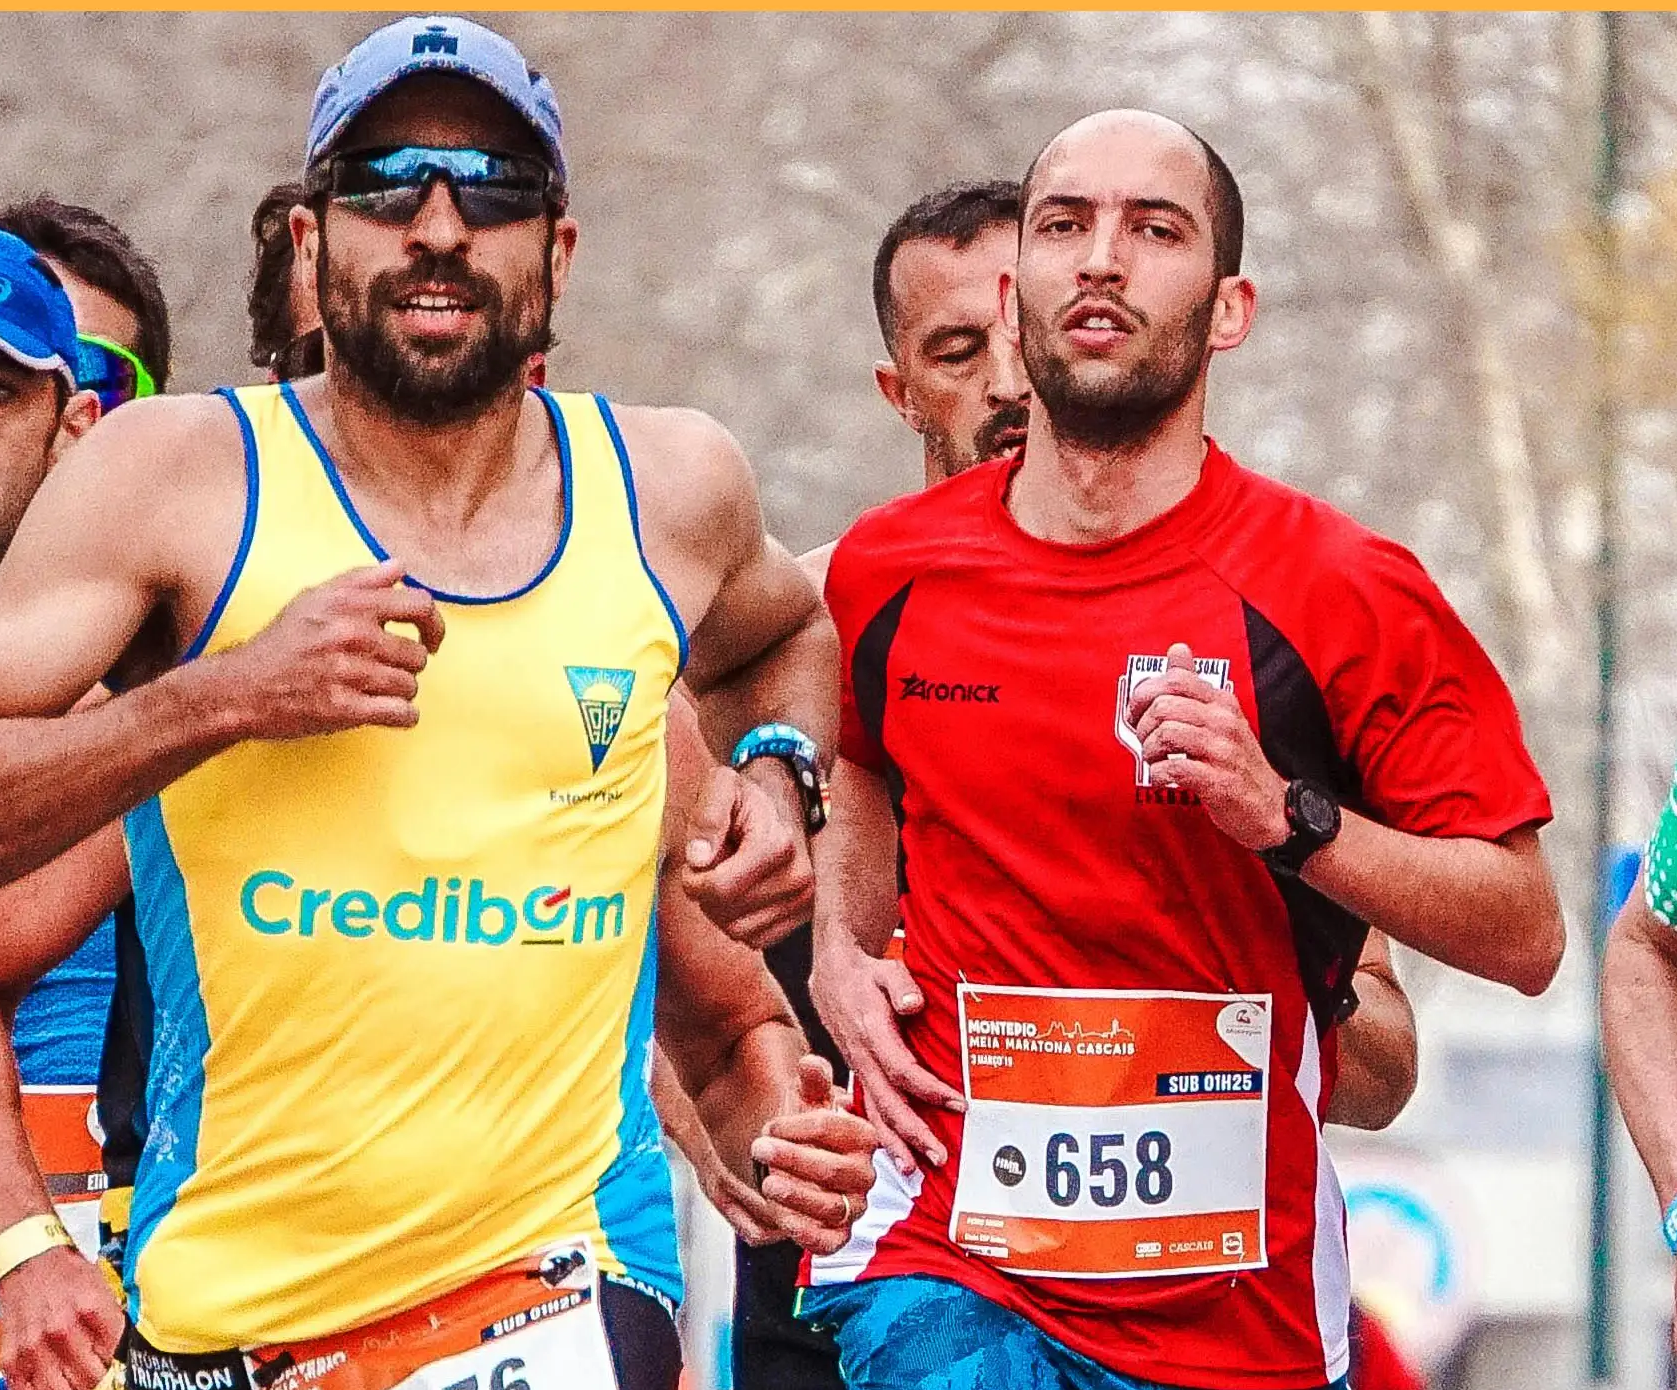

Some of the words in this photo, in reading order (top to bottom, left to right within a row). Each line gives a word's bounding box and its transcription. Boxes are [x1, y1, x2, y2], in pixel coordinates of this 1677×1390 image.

[1135, 657, 1163, 673] CLUBE
[239, 868, 625, 946] Credibom
[969, 1036, 1001, 1049] MEIA
[1005, 1038, 1073, 1055] MARATONA
[1076, 1042, 1136, 1056] CASCAIS
[1168, 1075, 1200, 1093] SUB
[1203, 1073, 1253, 1091] 01H25
[1045, 1130, 1174, 1208] 658
